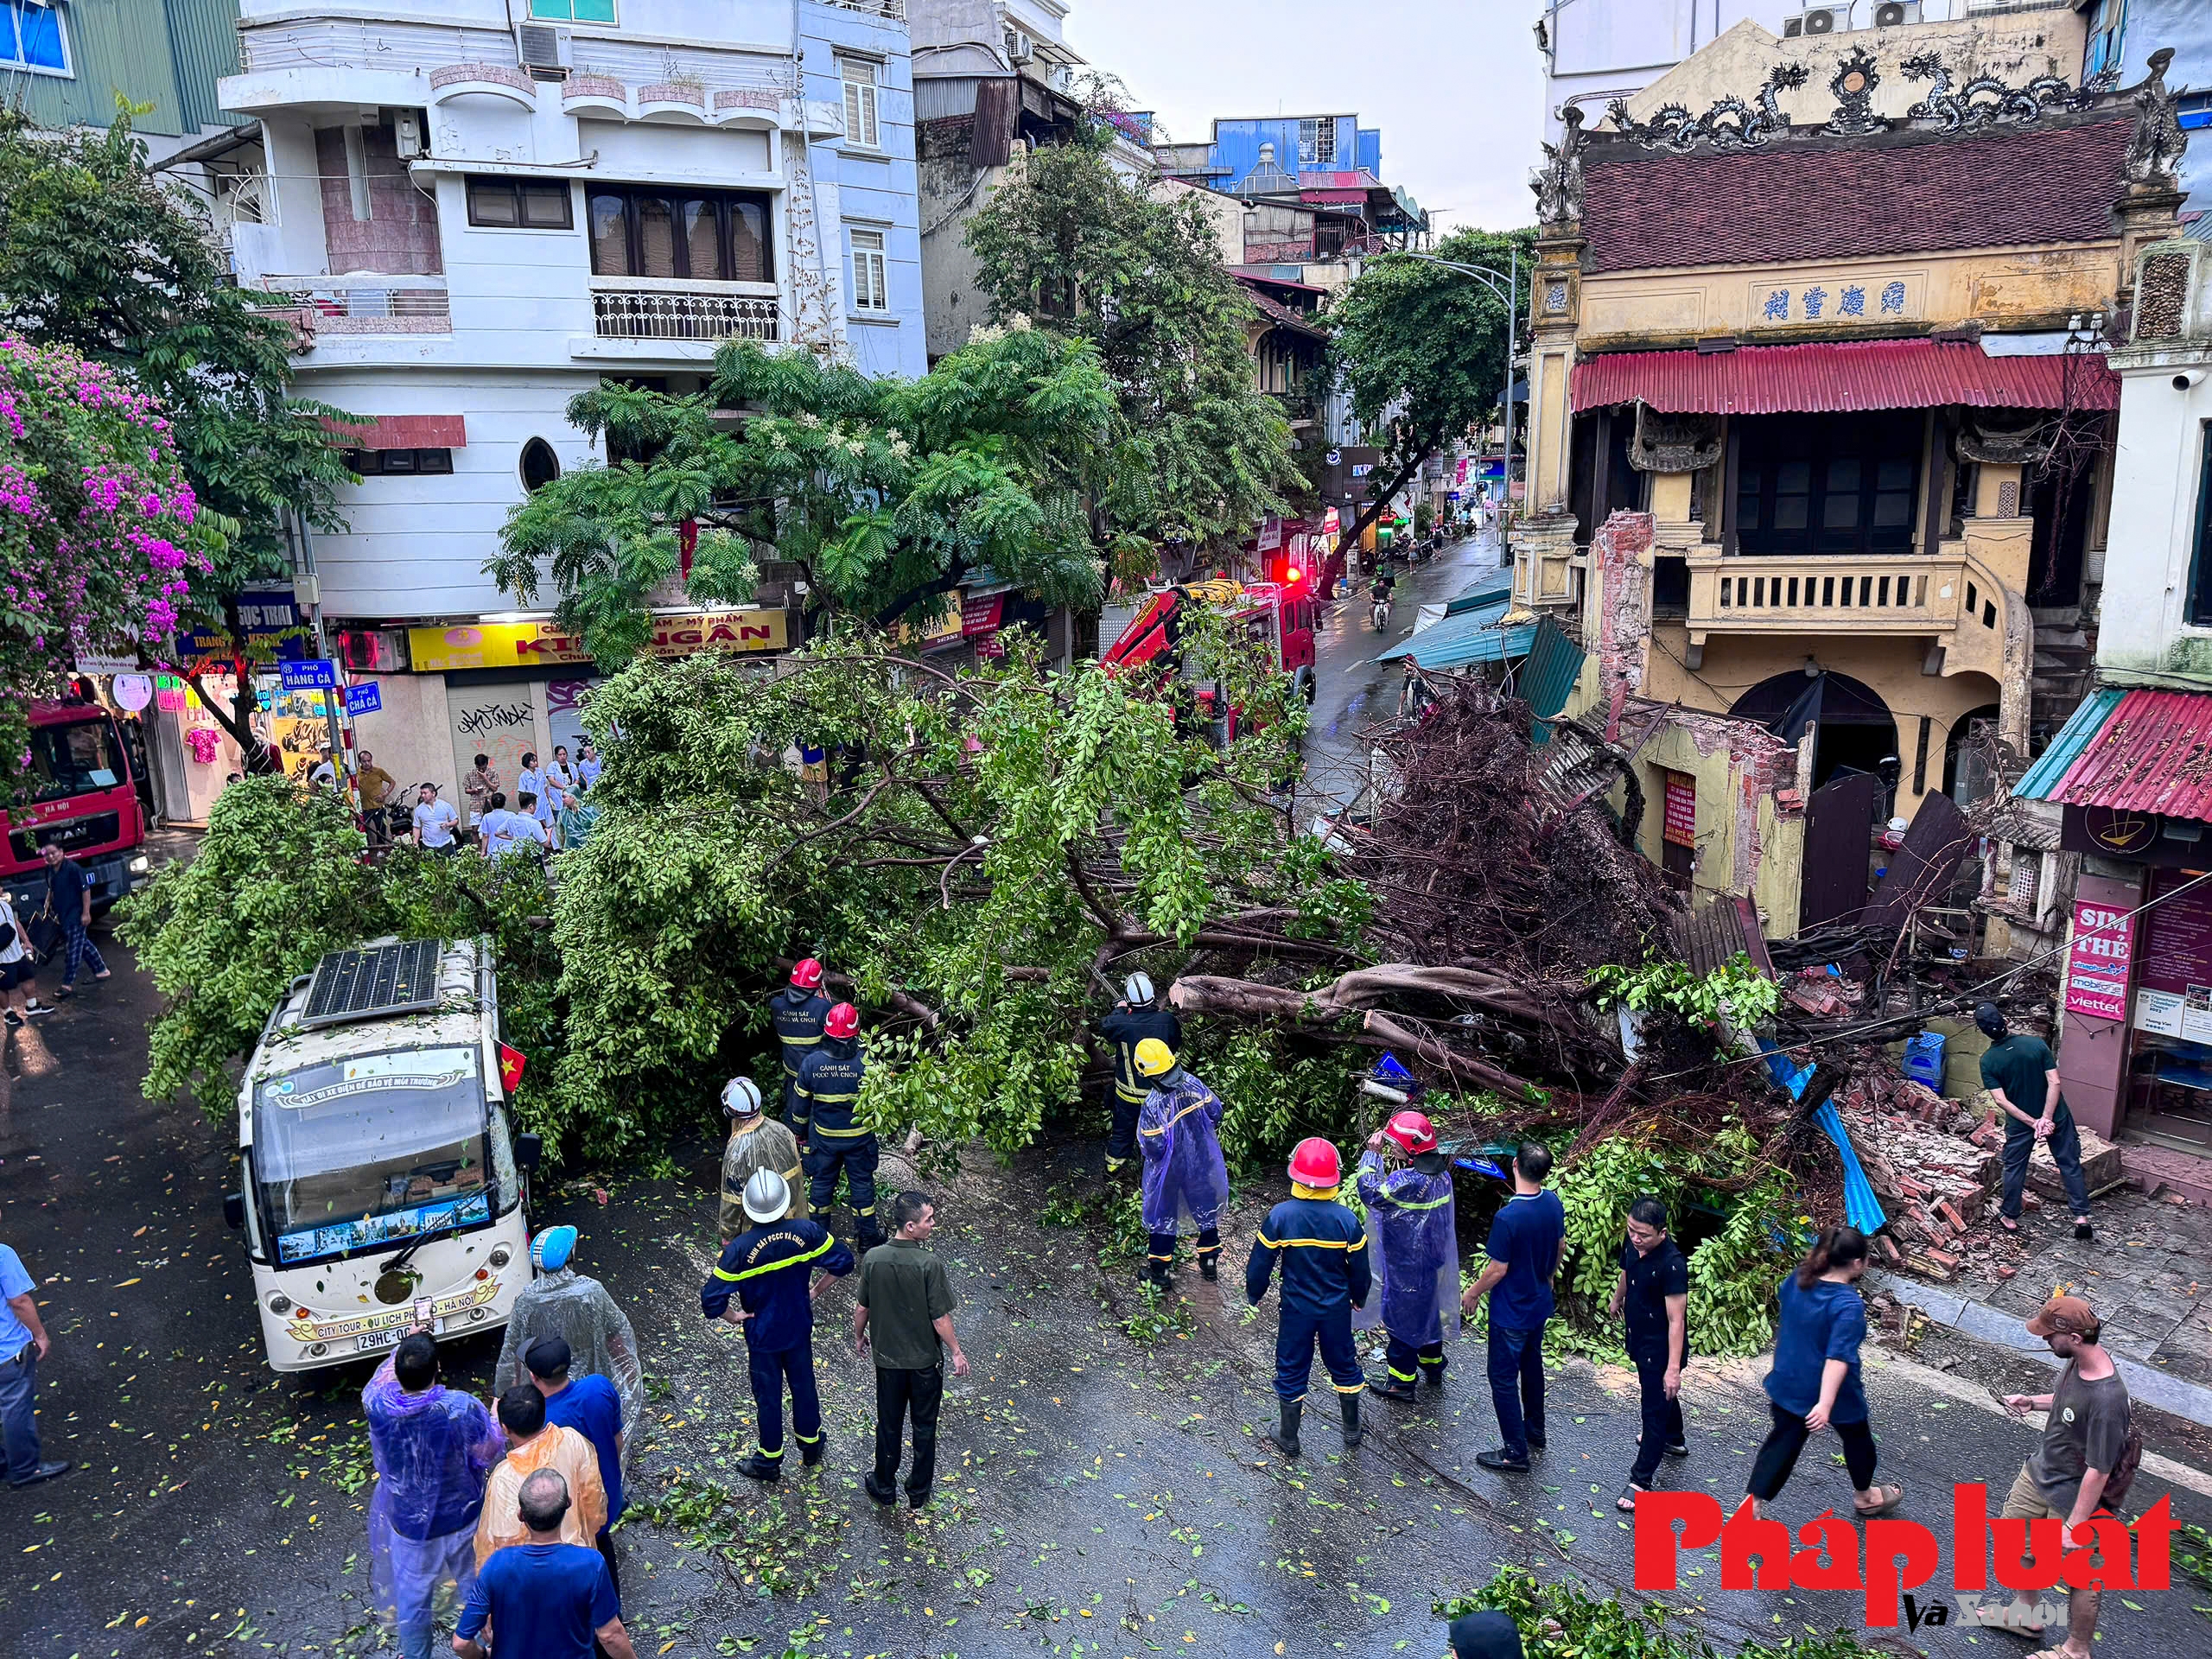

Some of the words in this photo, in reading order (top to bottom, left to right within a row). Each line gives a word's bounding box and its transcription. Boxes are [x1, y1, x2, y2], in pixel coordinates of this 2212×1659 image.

[261, 605, 293, 626] TRAI
[686, 615, 704, 626] MỸ
[709, 613, 743, 624] PHẨM
[1136, 597, 1158, 623] PALFINGER
[287, 672, 315, 686] HÀNG
[317, 671, 332, 684] CÁ
[358, 687, 369, 696] PHỐ
[349, 698, 366, 712] CHẢ
[366, 694, 378, 707] CÁ
[50, 826, 87, 841] MAN
[2081, 908, 2128, 933] SIM
[2074, 933, 2129, 960] THẺ
[2072, 961, 2115, 975] vinaphone
[2072, 978, 2122, 993] mobifone
[2070, 995, 2120, 1014] viettel
[327, 1088, 337, 1097] XE
[338, 1084, 355, 1096] ĐIỆN
[367, 1077, 382, 1089] BẢO
[384, 1077, 393, 1087] VỆ
[393, 1077, 408, 1086] MÔI
[747, 1248, 760, 1264] CẢNH
[757, 1237, 767, 1249] SÁT
[767, 1232, 783, 1243] PCCC
[791, 1234, 805, 1248] CNCH
[318, 1325, 337, 1338] CITY
[338, 1322, 361, 1334] TOUR
[444, 1300, 456, 1311] HÀ
[459, 1296, 474, 1308] NỘI
